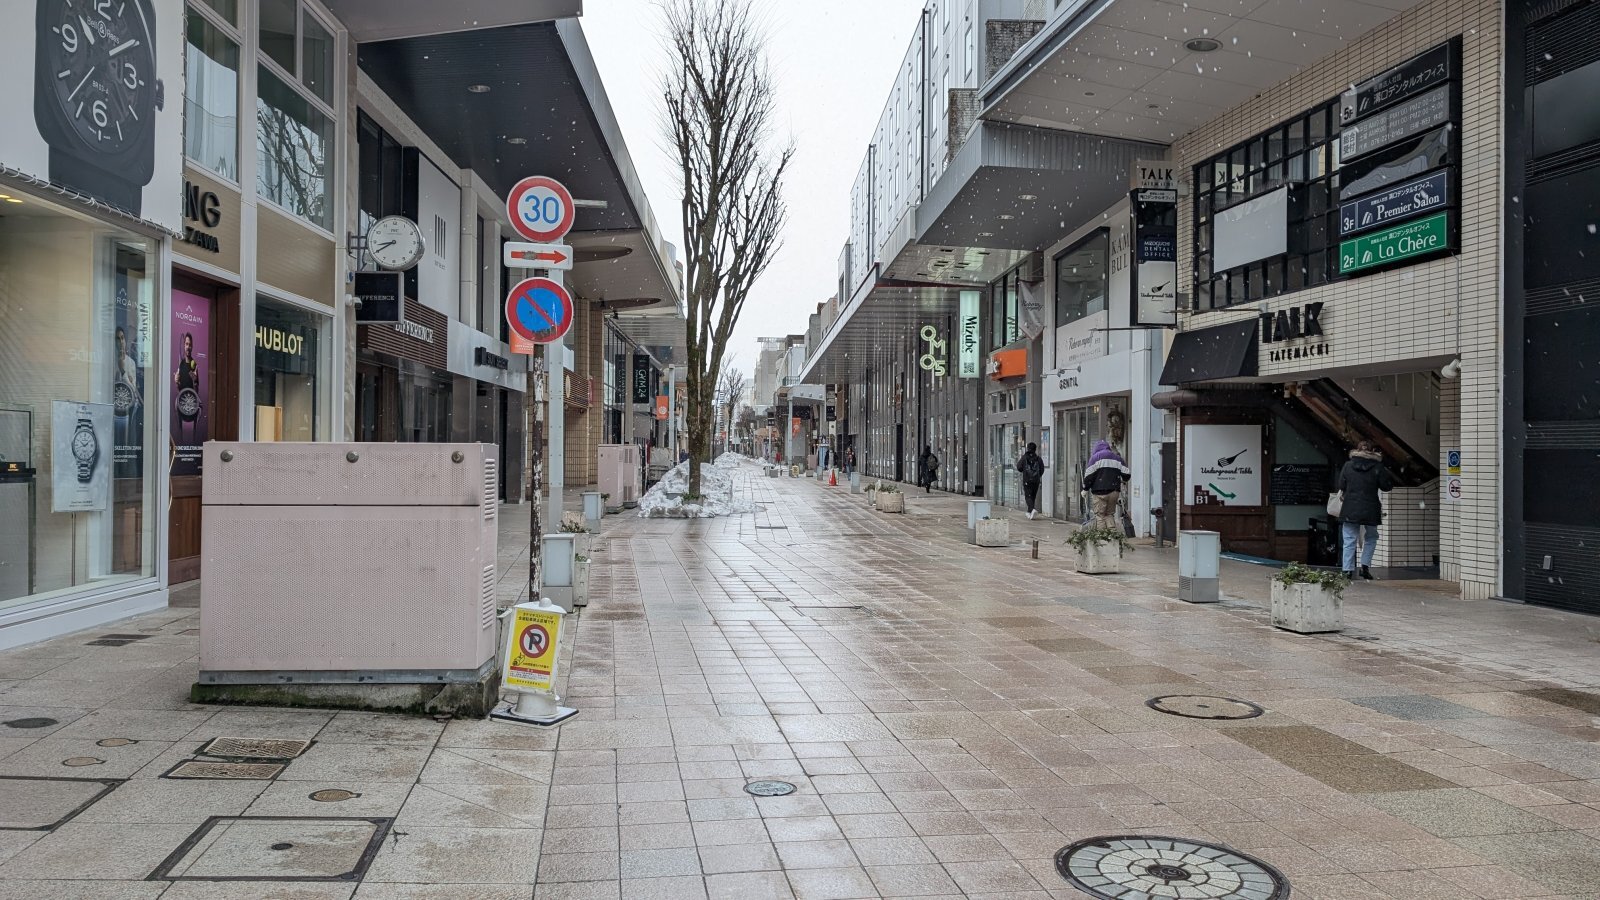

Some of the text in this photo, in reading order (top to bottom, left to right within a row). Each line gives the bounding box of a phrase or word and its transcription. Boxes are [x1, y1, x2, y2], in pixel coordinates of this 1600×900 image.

[61, 23, 78, 53] 9
[123, 62, 137, 90] 3
[92, 99, 108, 128] 6
[1343, 107, 1354, 121] 5F
[1140, 167, 1173, 180] TALK
[185, 181, 221, 228] NG
[523, 194, 560, 225] 30
[1376, 192, 1440, 221] Premier Salon
[1343, 217, 1354, 232] 3F
[184, 225, 220, 254] ZAWA
[1378, 243, 1394, 259] La
[1397, 234, 1437, 254] Chère
[1343, 254, 1354, 269] 2F
[175, 311, 203, 324] NORQAIN
[1259, 301, 1325, 344] TALK
[395, 320, 434, 344] DIFFERENCE
[965, 315, 978, 353] Mizube
[1269, 343, 1329, 362] TATEMACHI
[1200, 467, 1253, 477] Underground Table
[1195, 495, 1209, 505] B1
